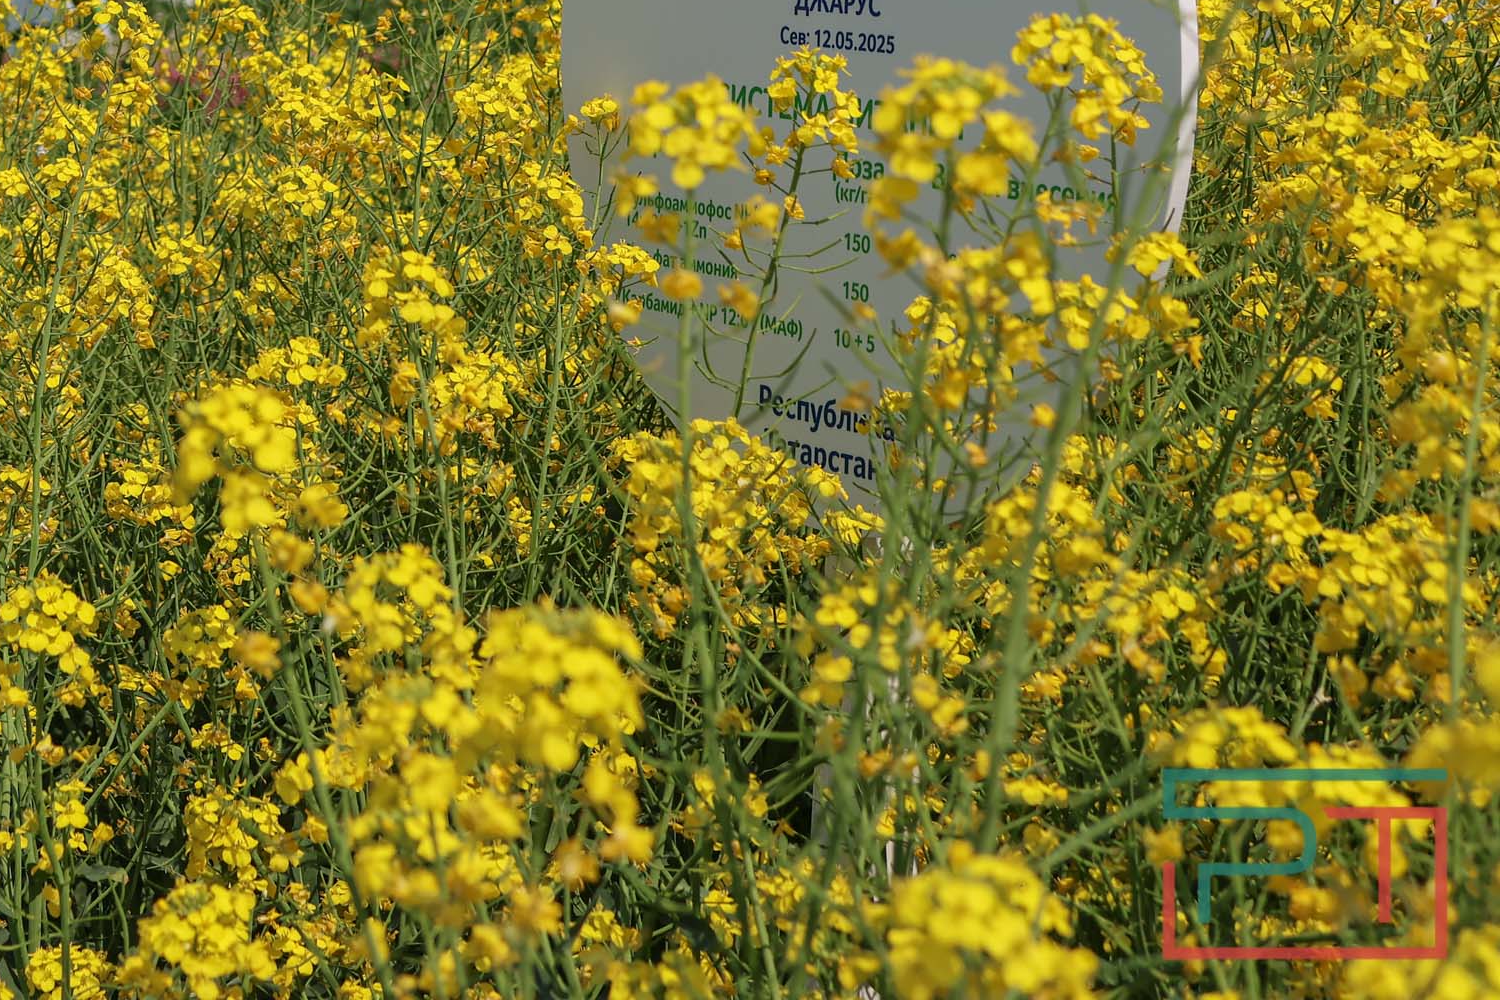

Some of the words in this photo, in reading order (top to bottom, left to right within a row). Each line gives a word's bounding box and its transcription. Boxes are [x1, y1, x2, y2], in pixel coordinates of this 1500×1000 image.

[780, 26, 810, 46] Сев:
[814, 29, 895, 54] 12.05.2025
[719, 83, 831, 121] ИСТМА
[844, 233, 871, 253] 150
[682, 257, 738, 279] мония
[843, 281, 869, 302] 150
[622, 289, 685, 319] Кбами
[759, 313, 803, 342] (МАФ)
[834, 329, 851, 349] 10
[866, 335, 876, 353] 5
[763, 427, 878, 481] тарста
